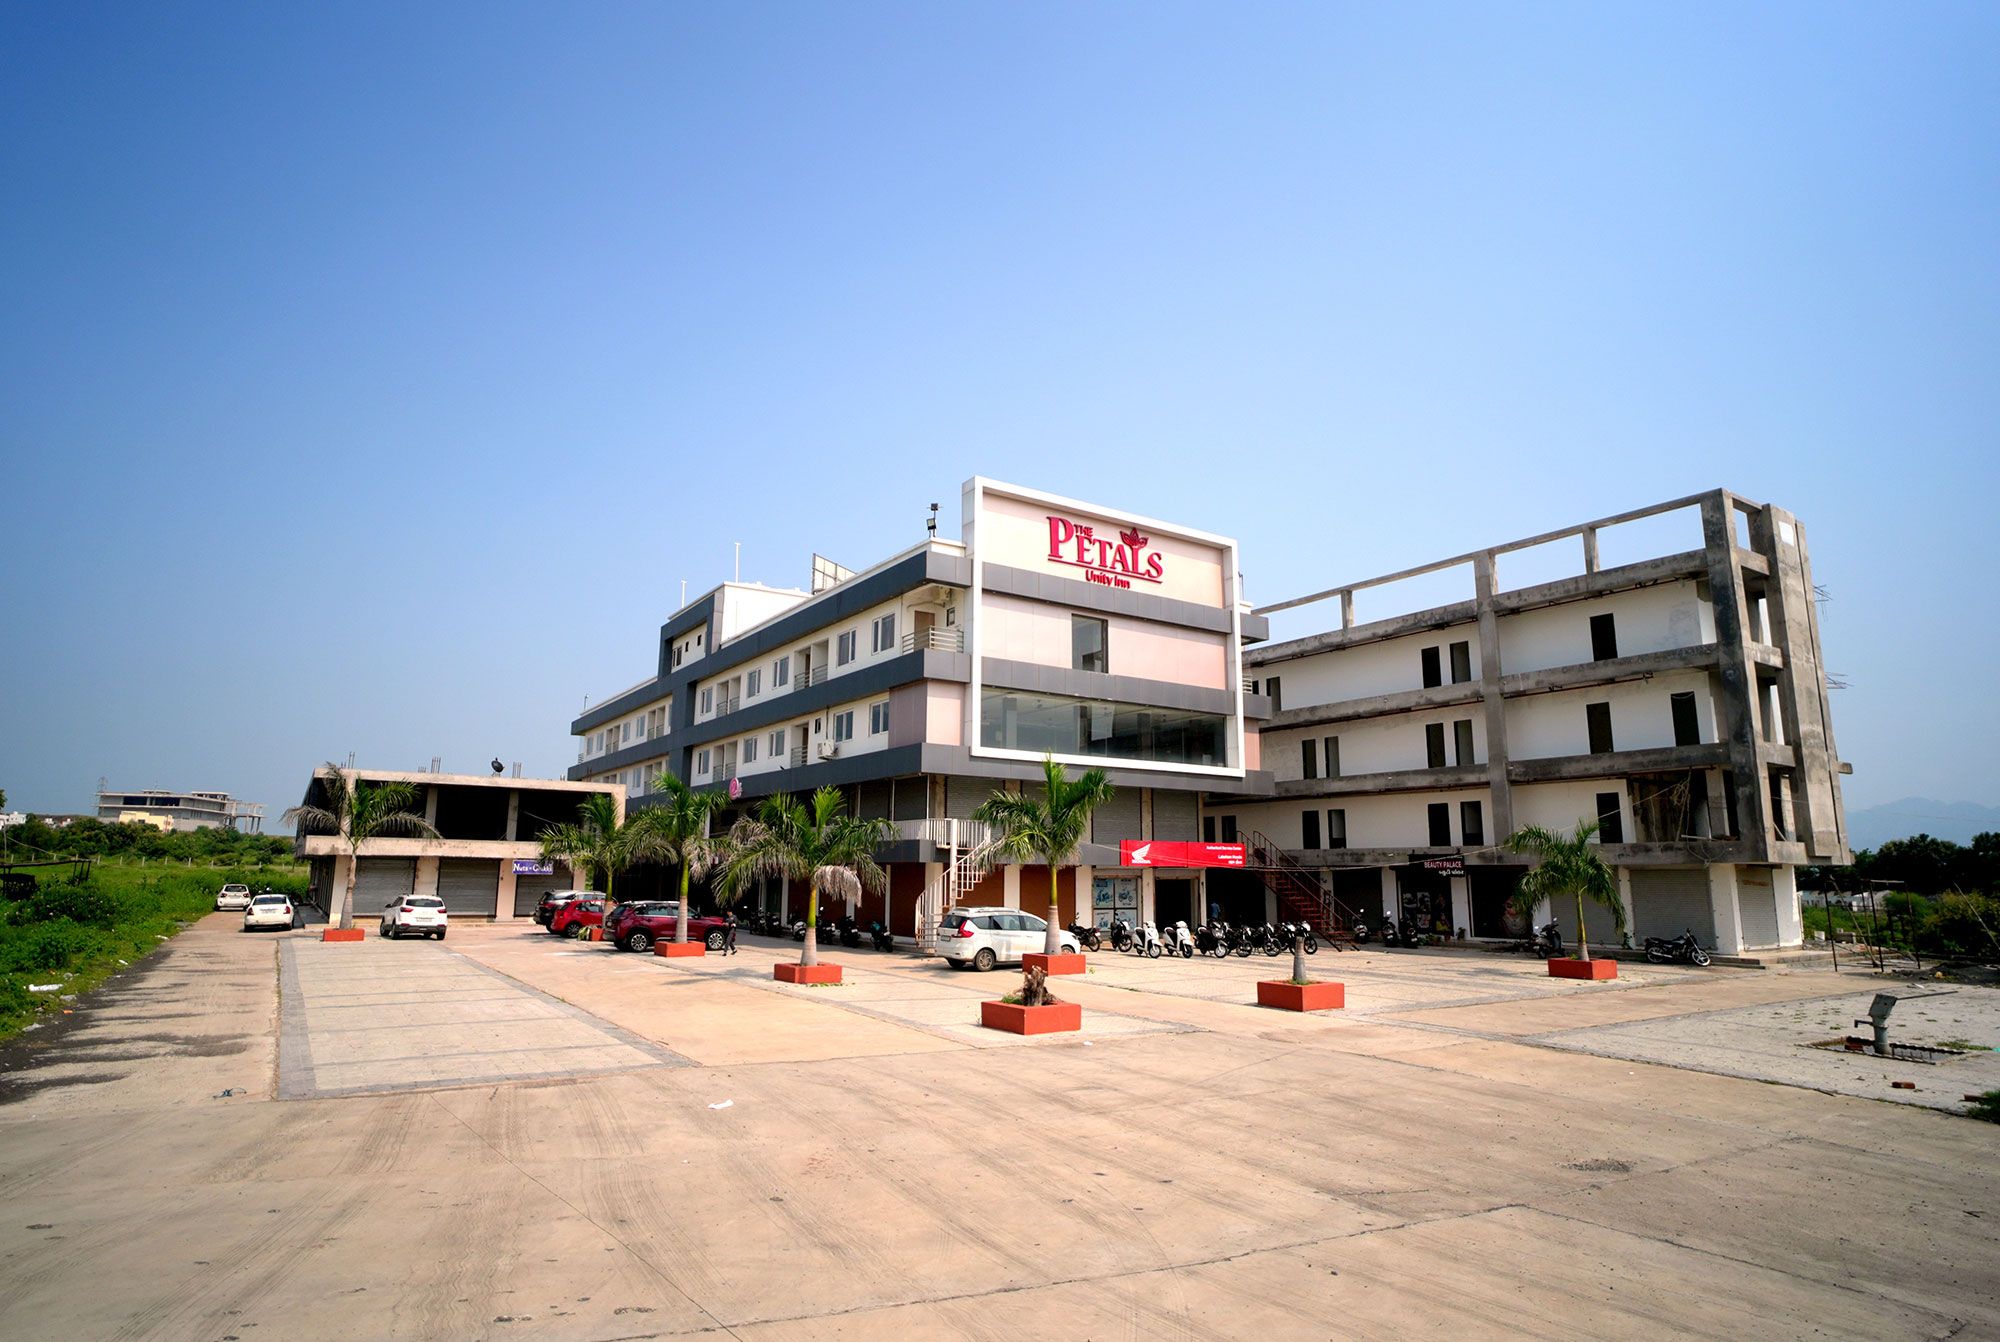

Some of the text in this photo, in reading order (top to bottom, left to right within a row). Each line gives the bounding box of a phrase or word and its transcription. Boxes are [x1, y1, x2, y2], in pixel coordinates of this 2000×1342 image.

[1073, 523, 1094, 538] THE
[1046, 516, 1164, 579] PETALS
[1085, 569, 1131, 590] Unity Inn
[1424, 861, 1442, 869] BEAUTY
